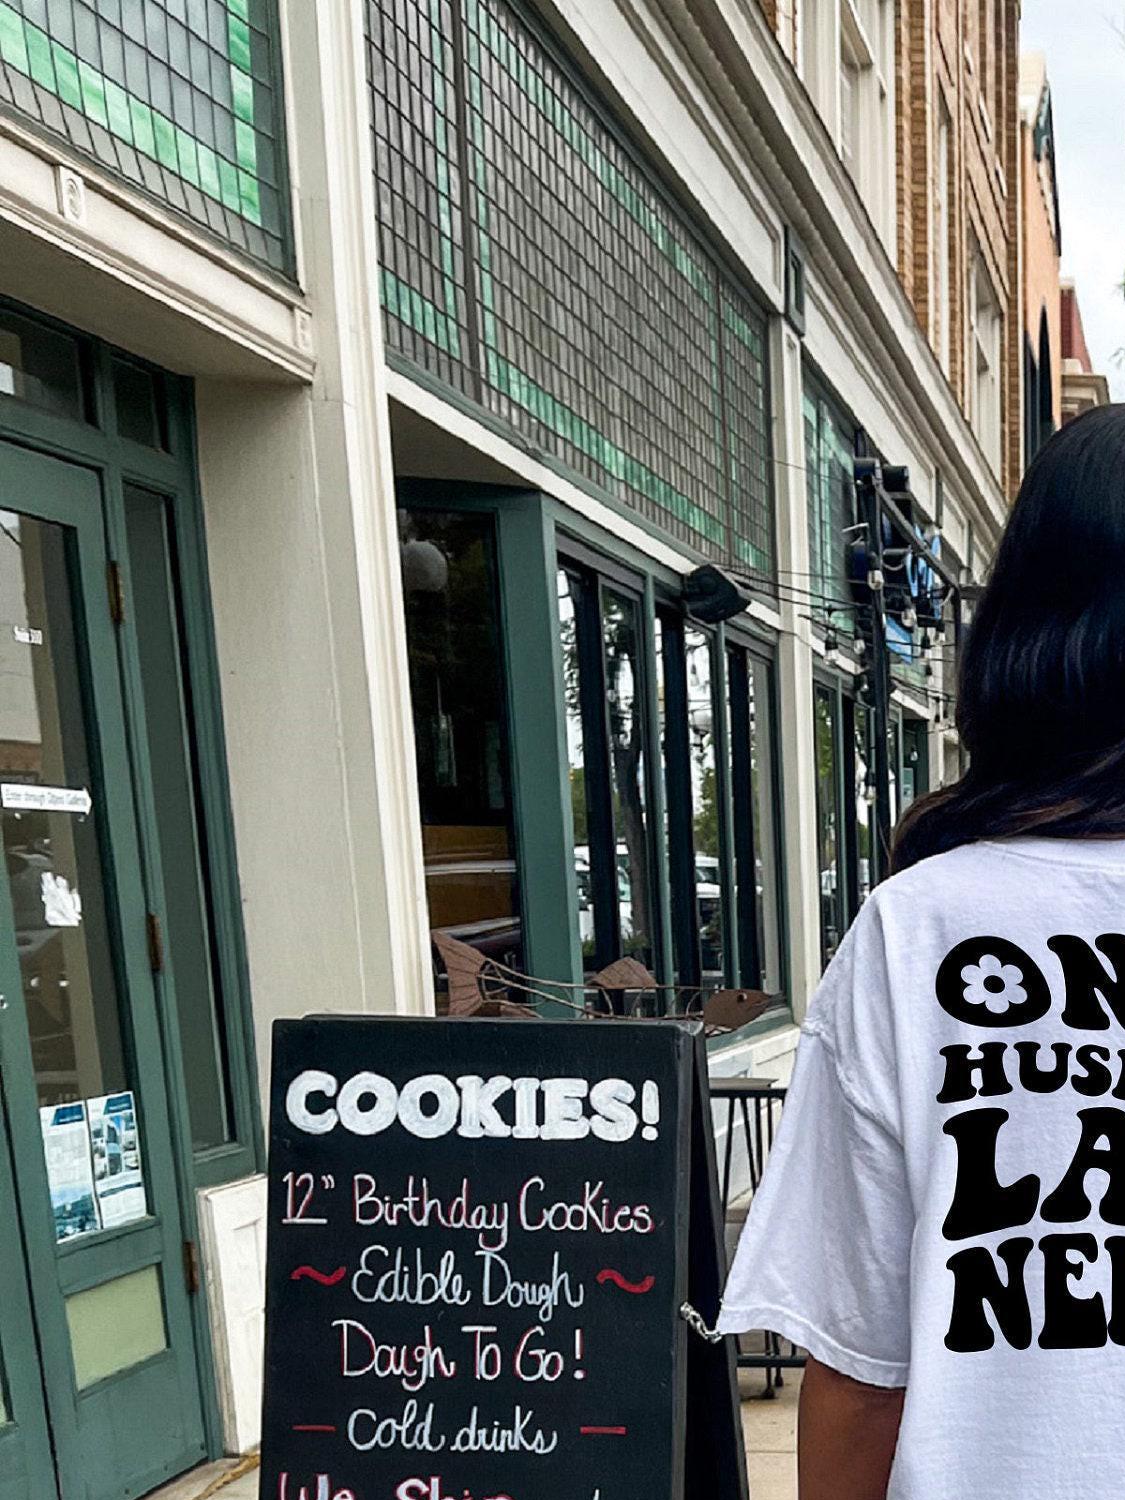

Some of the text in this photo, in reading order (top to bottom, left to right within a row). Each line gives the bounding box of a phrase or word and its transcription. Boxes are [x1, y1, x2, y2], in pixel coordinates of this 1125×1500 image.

[285, 1070, 660, 1142] COOKIES!
[352, 1173, 509, 1251] Birthday
[351, 1244, 584, 1322] Edible Dough
[462, 1325, 501, 1381] To
[347, 1400, 446, 1452] Cold
